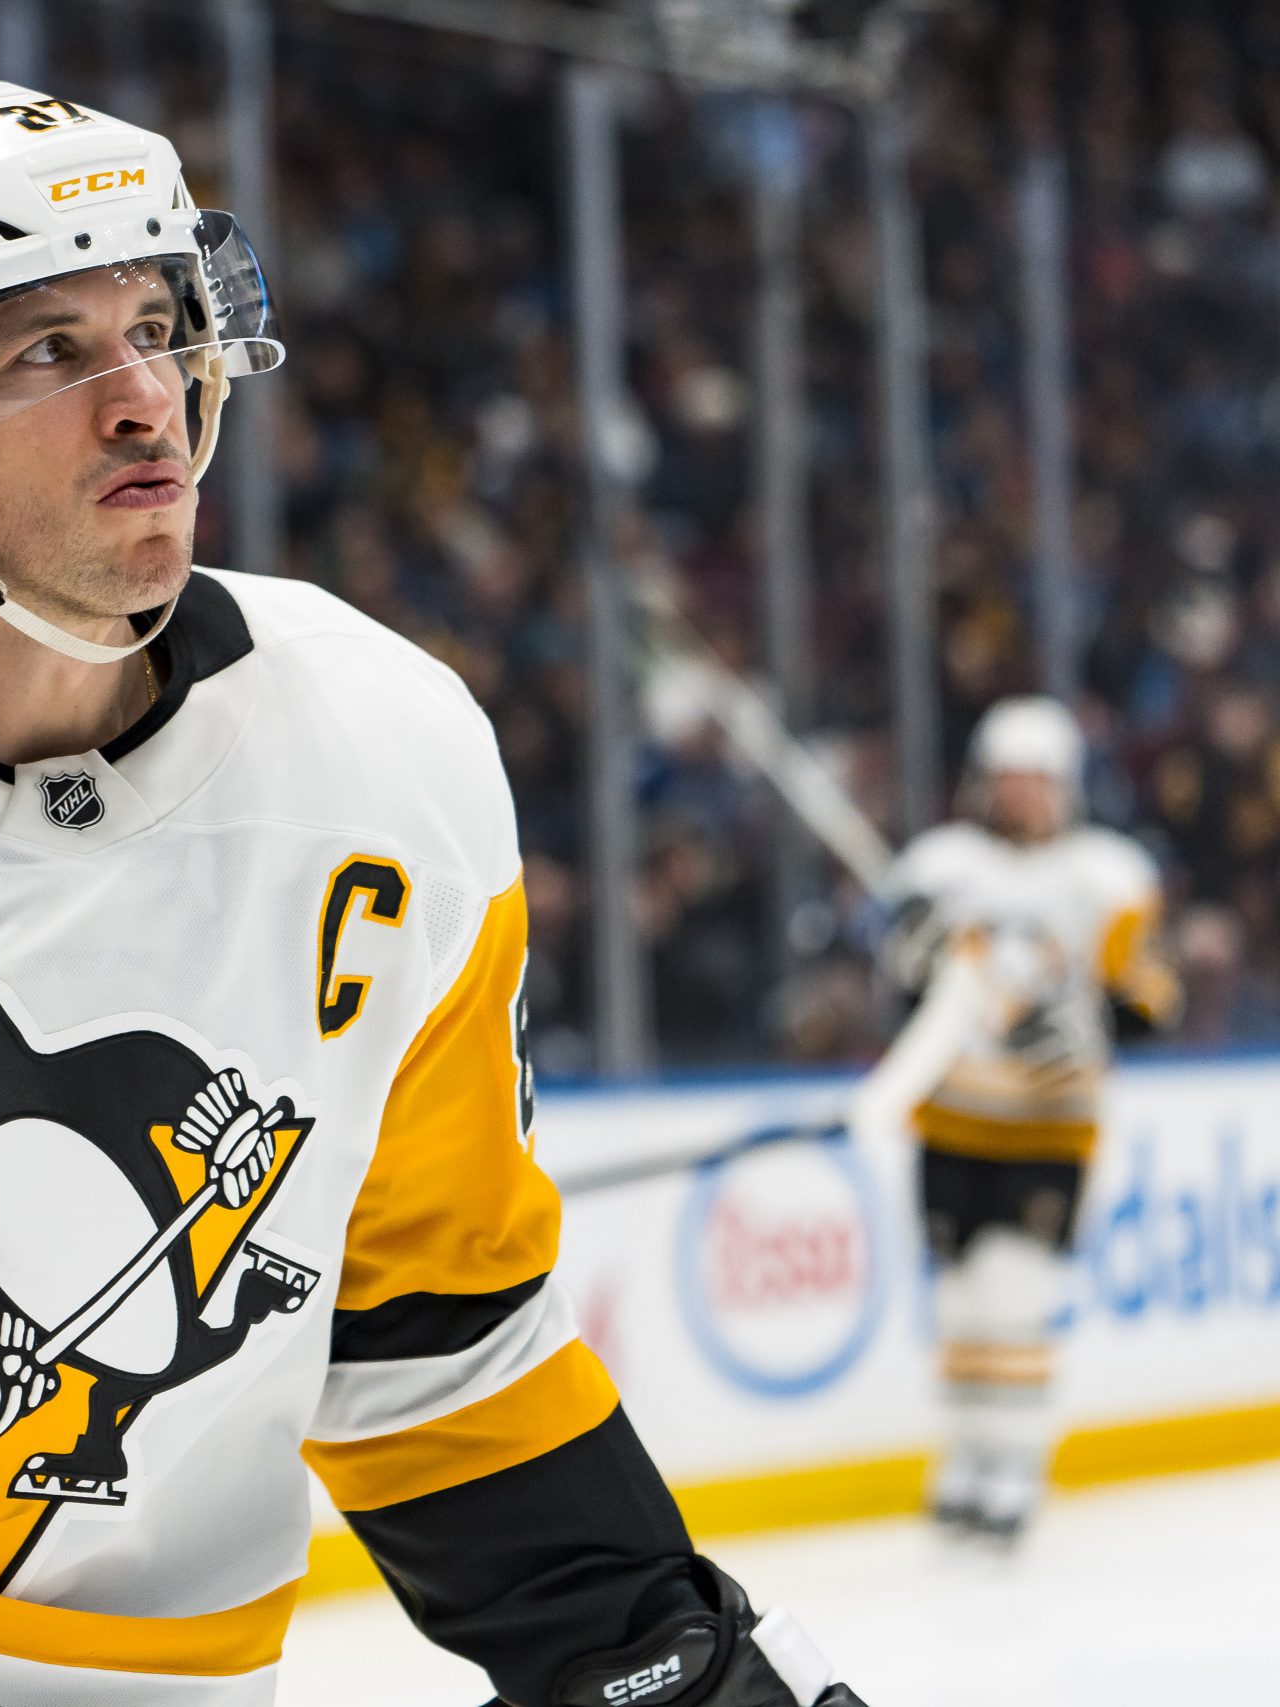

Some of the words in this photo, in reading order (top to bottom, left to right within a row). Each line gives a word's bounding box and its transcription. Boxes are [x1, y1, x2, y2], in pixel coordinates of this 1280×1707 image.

[48, 168, 145, 202] CCM
[57, 785, 90, 821] NHL
[316, 852, 412, 1042] C
[603, 1654, 681, 1700] CCM
